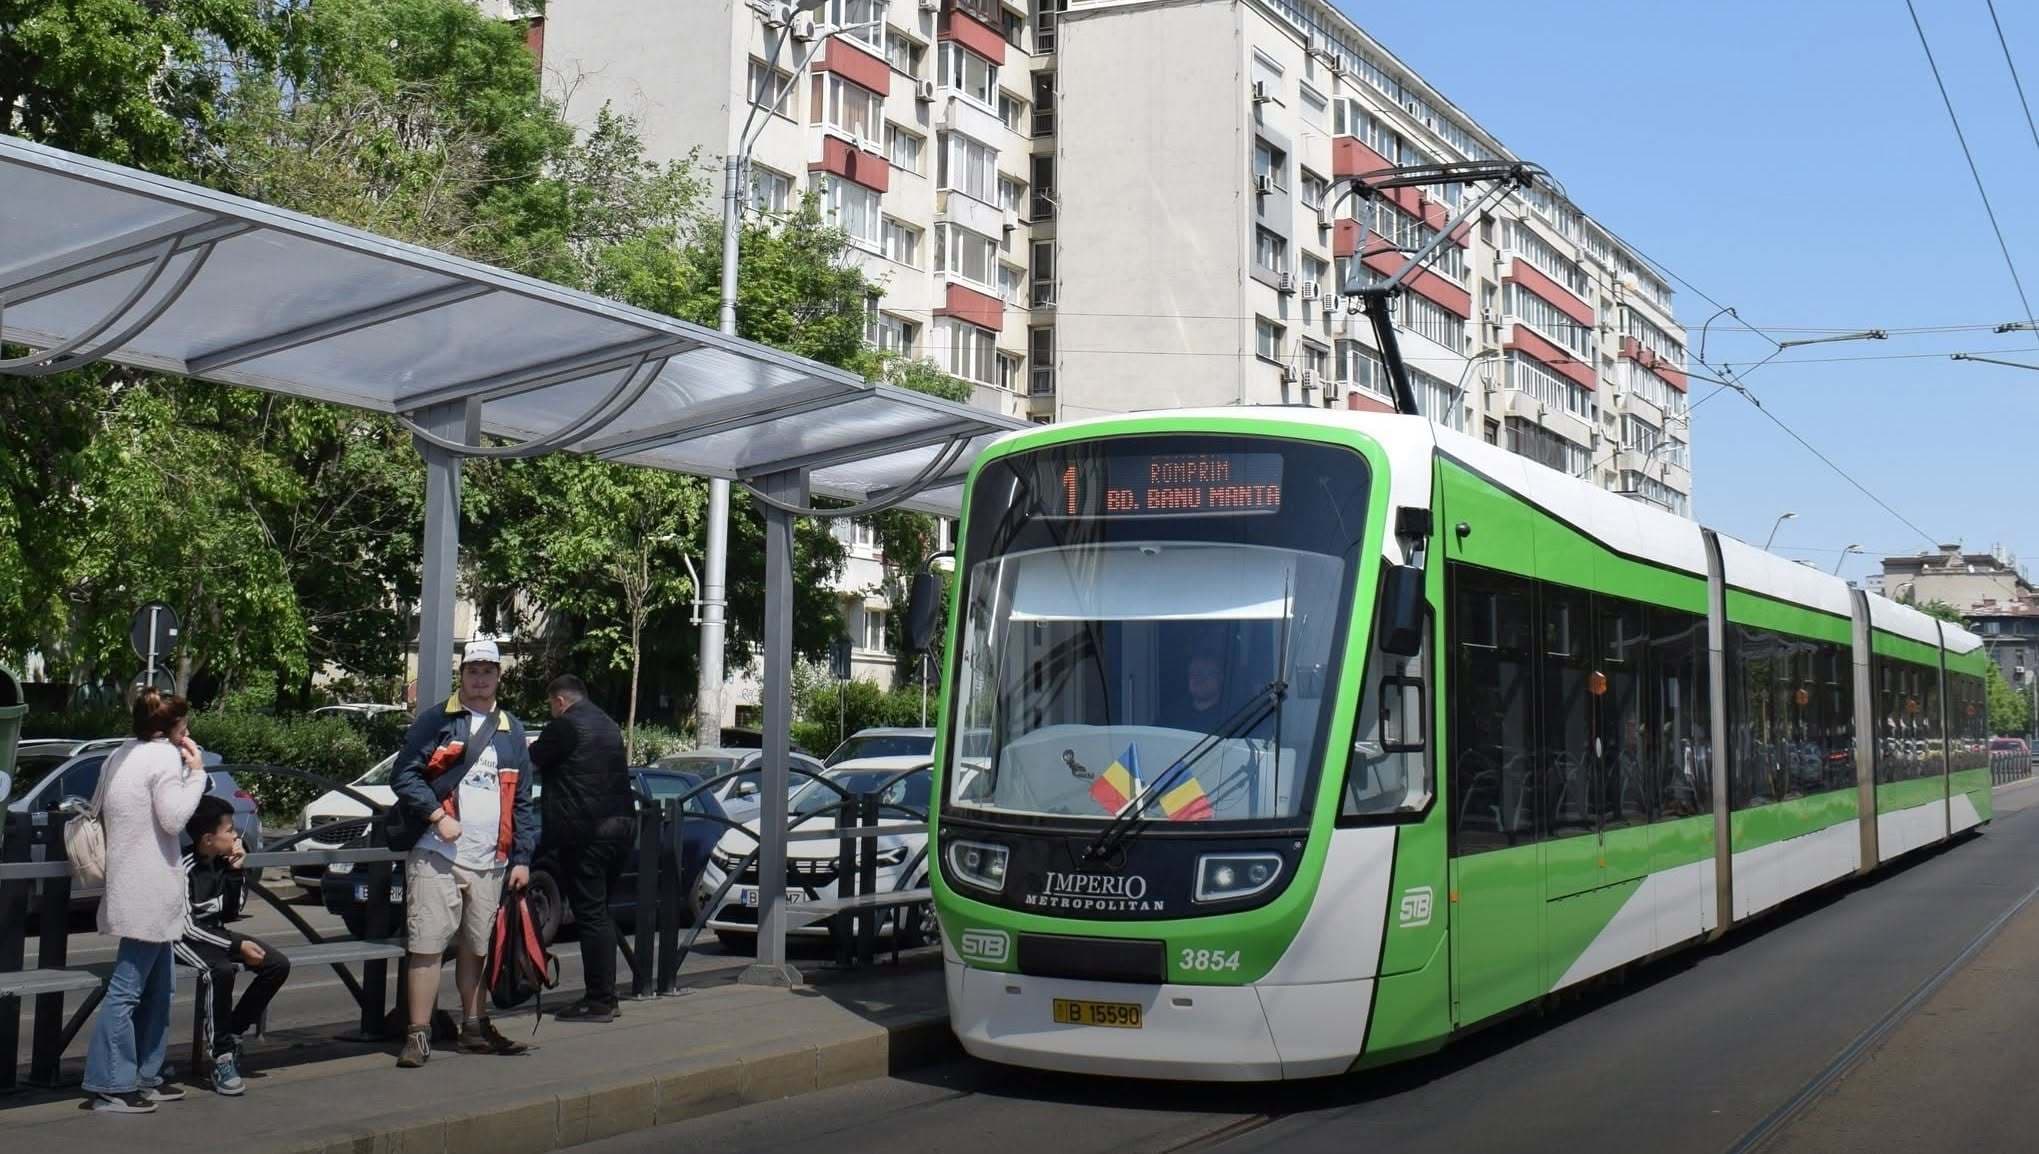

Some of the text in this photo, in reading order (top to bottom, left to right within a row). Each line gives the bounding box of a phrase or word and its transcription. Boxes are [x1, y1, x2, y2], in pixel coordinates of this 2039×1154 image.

[1151, 461, 1229, 484] ROMPRIM
[1063, 466, 1077, 514] 1
[1107, 489, 1140, 510] BD.
[1147, 487, 1201, 509] BANU
[1043, 872, 1147, 899] IMPERIO
[1025, 894, 1165, 911] METROPOLITAN
[1400, 893, 1431, 921] STB
[962, 932, 1005, 958] STB
[1179, 949, 1240, 971] 3854
[1070, 1004, 1139, 1025] B 15590
